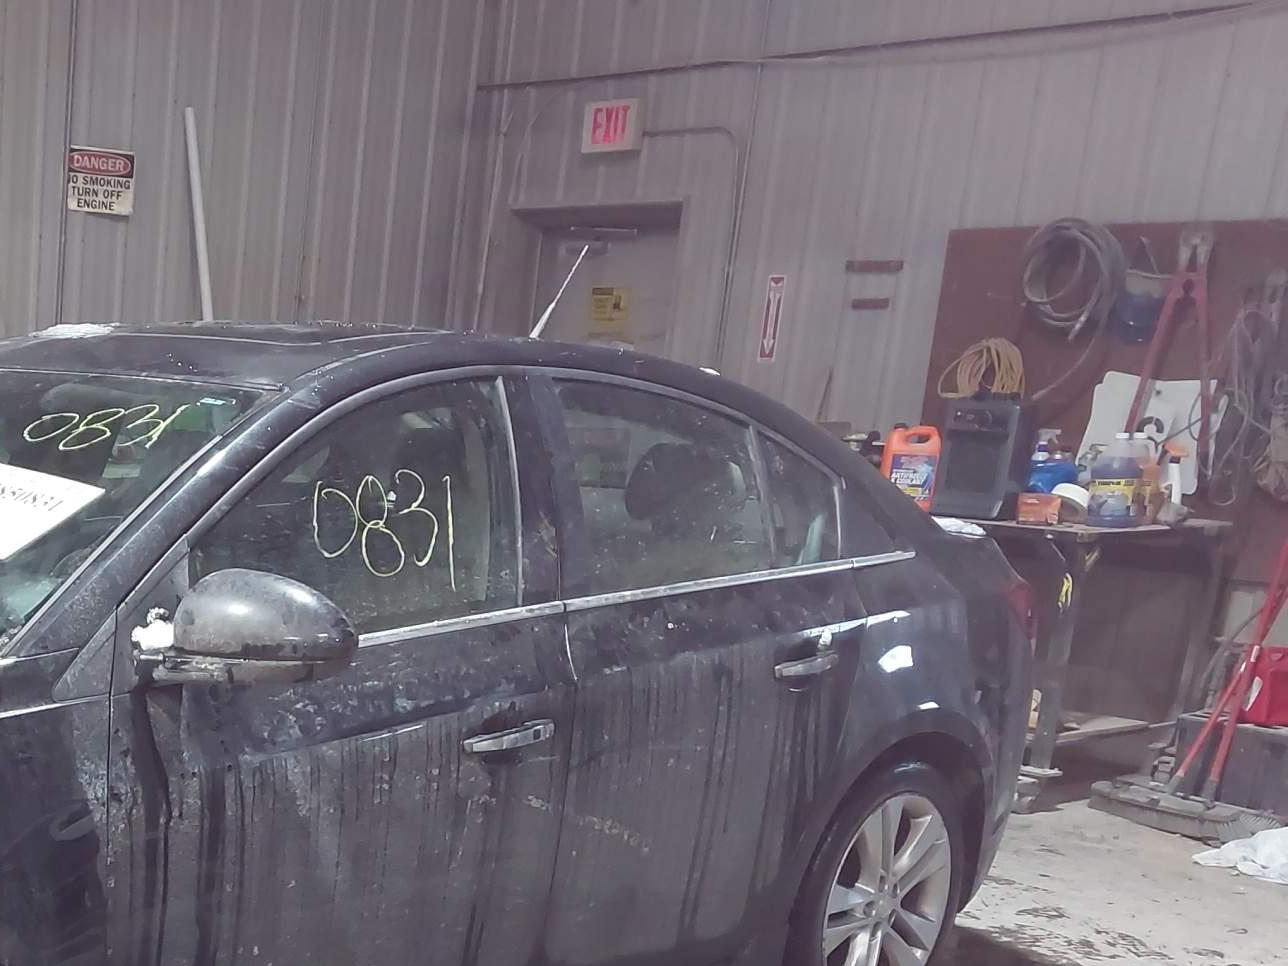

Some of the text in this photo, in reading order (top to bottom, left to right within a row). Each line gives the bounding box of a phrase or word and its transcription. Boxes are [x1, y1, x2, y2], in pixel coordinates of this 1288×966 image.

[591, 104, 631, 144] EXIT
[73, 154, 125, 172] DANGER
[82, 175, 131, 190] SMOKING
[72, 186, 123, 201] TURN OFF
[76, 198, 116, 211] ENGINE
[22, 403, 190, 450] 0831
[313, 468, 456, 592] 0831
